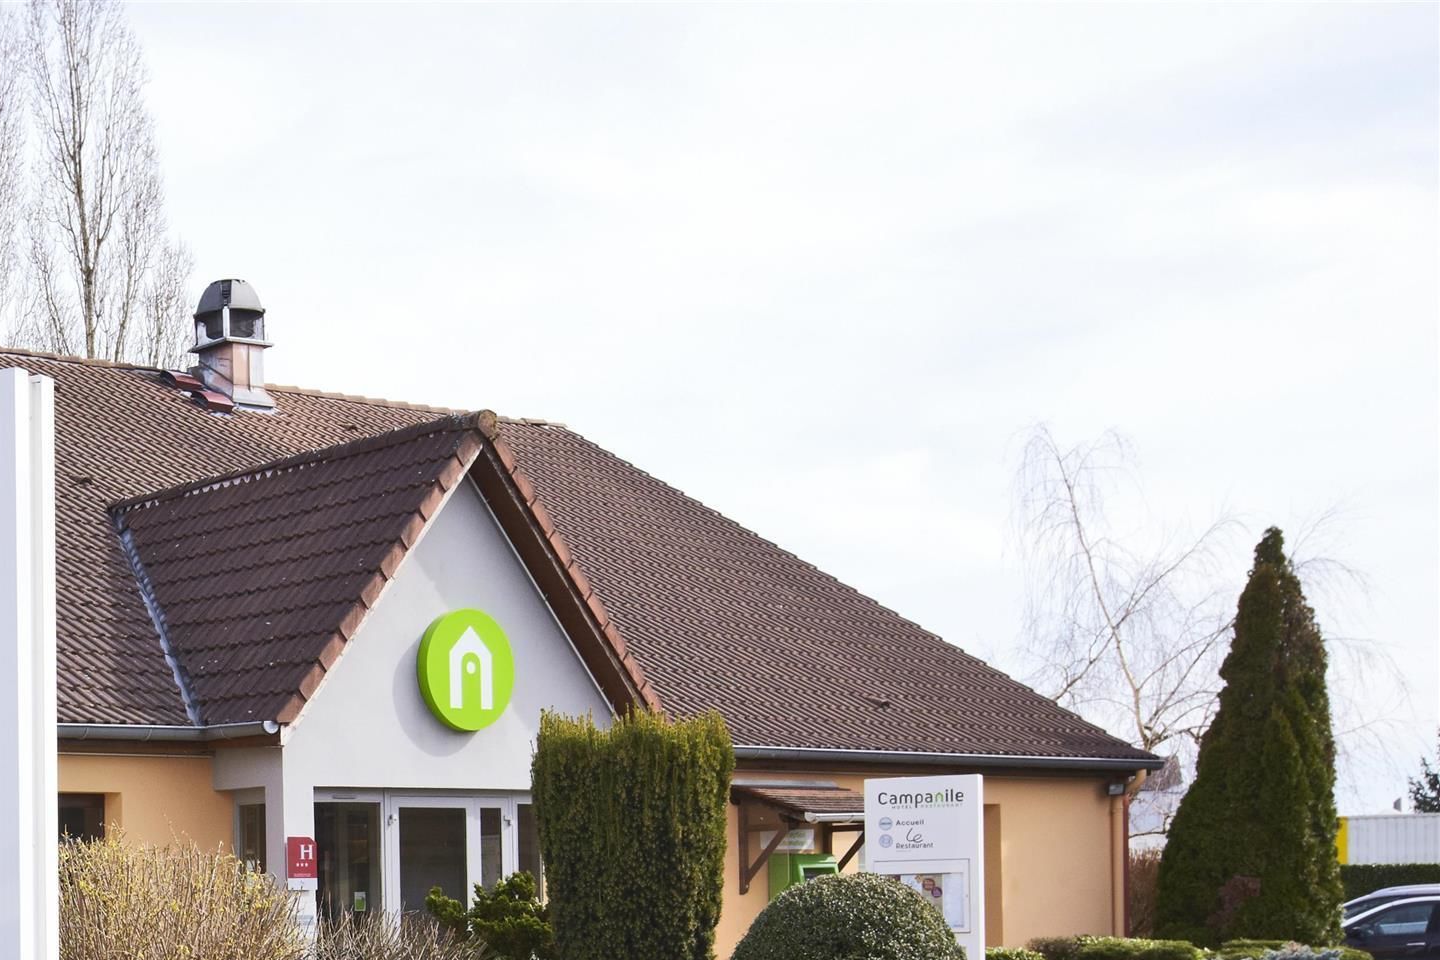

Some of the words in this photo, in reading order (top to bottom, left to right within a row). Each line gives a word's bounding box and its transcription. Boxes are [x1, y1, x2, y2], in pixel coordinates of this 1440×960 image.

[877, 788, 964, 809] Campanile
[300, 844, 313, 860] H
[895, 842, 934, 850] Restaurant
